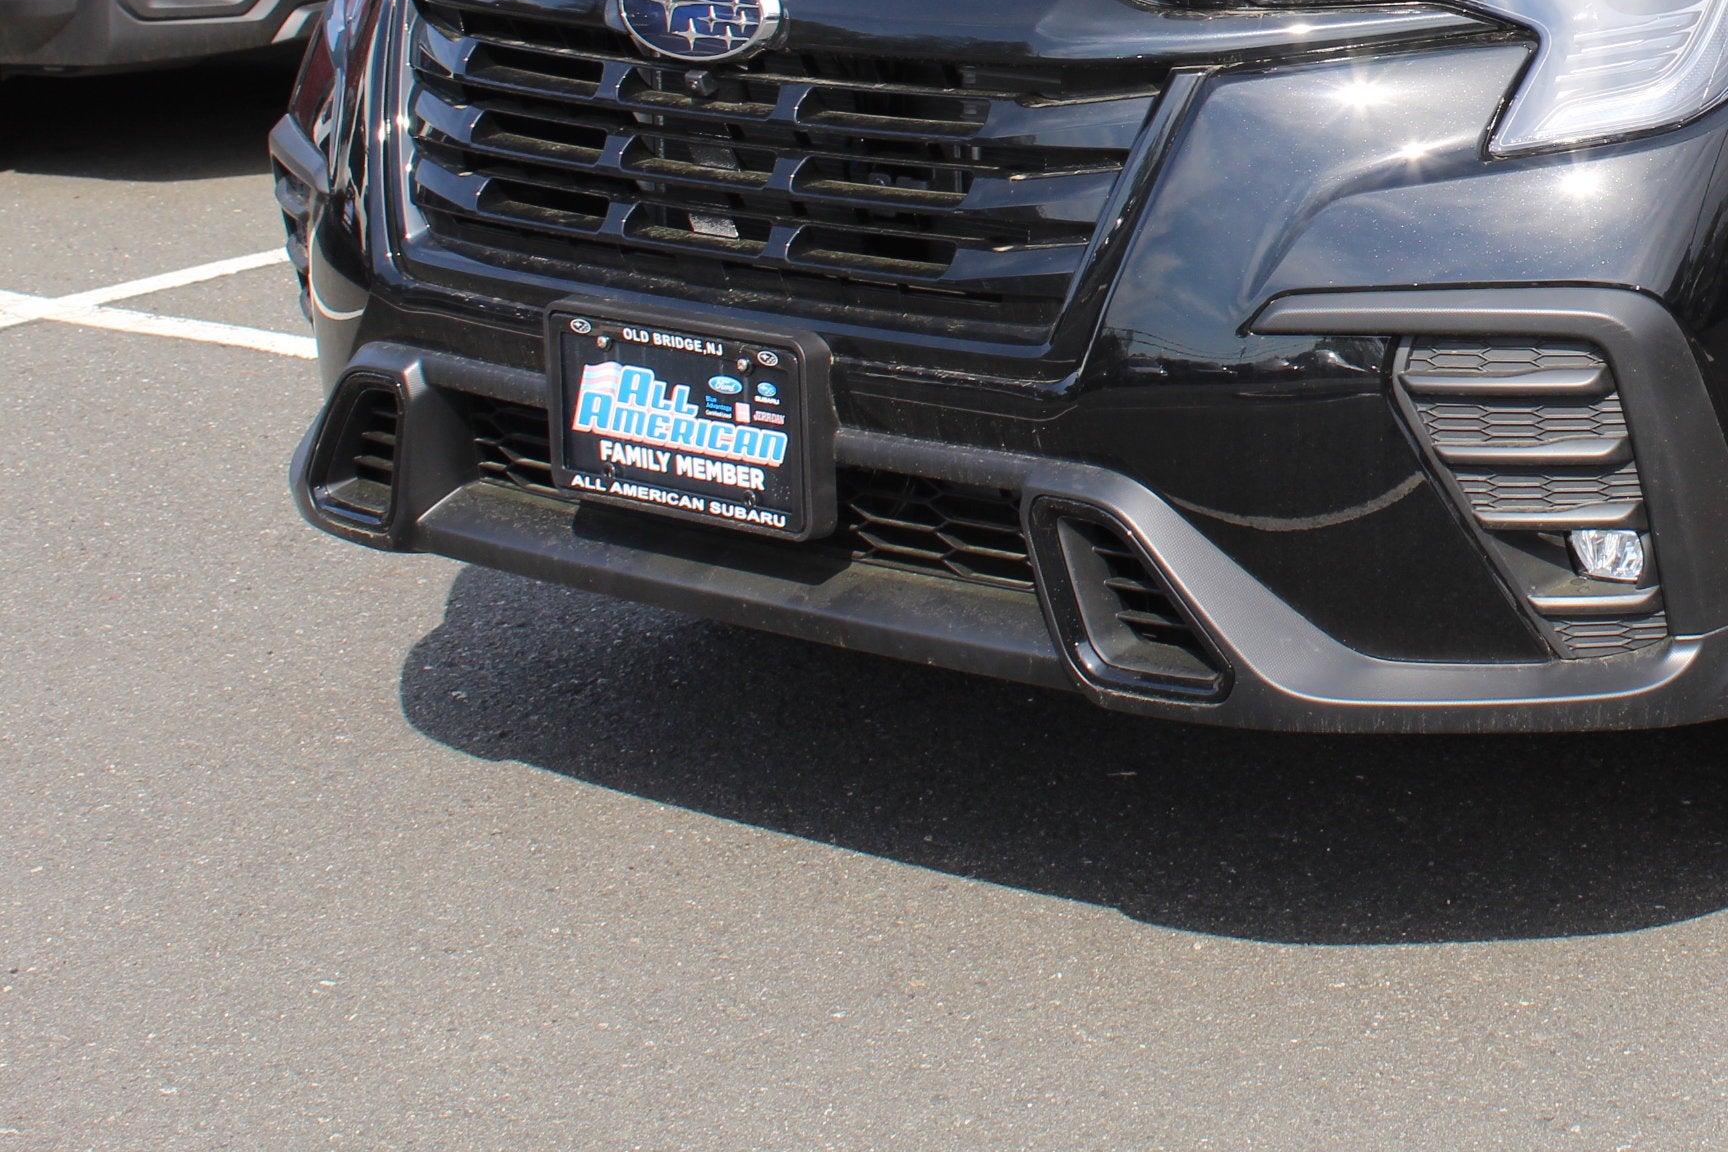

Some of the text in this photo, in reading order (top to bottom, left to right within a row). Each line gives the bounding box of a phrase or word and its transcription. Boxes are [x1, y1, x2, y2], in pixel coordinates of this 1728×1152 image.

[623, 328, 723, 356] OLD BRIDGE,NJ
[754, 395, 780, 406] SUBARU
[573, 391, 788, 464] AMERICAN
[600, 439, 765, 492] FAMILY MEMBER
[571, 474, 786, 529] ALL AMERICAN SUBARU
